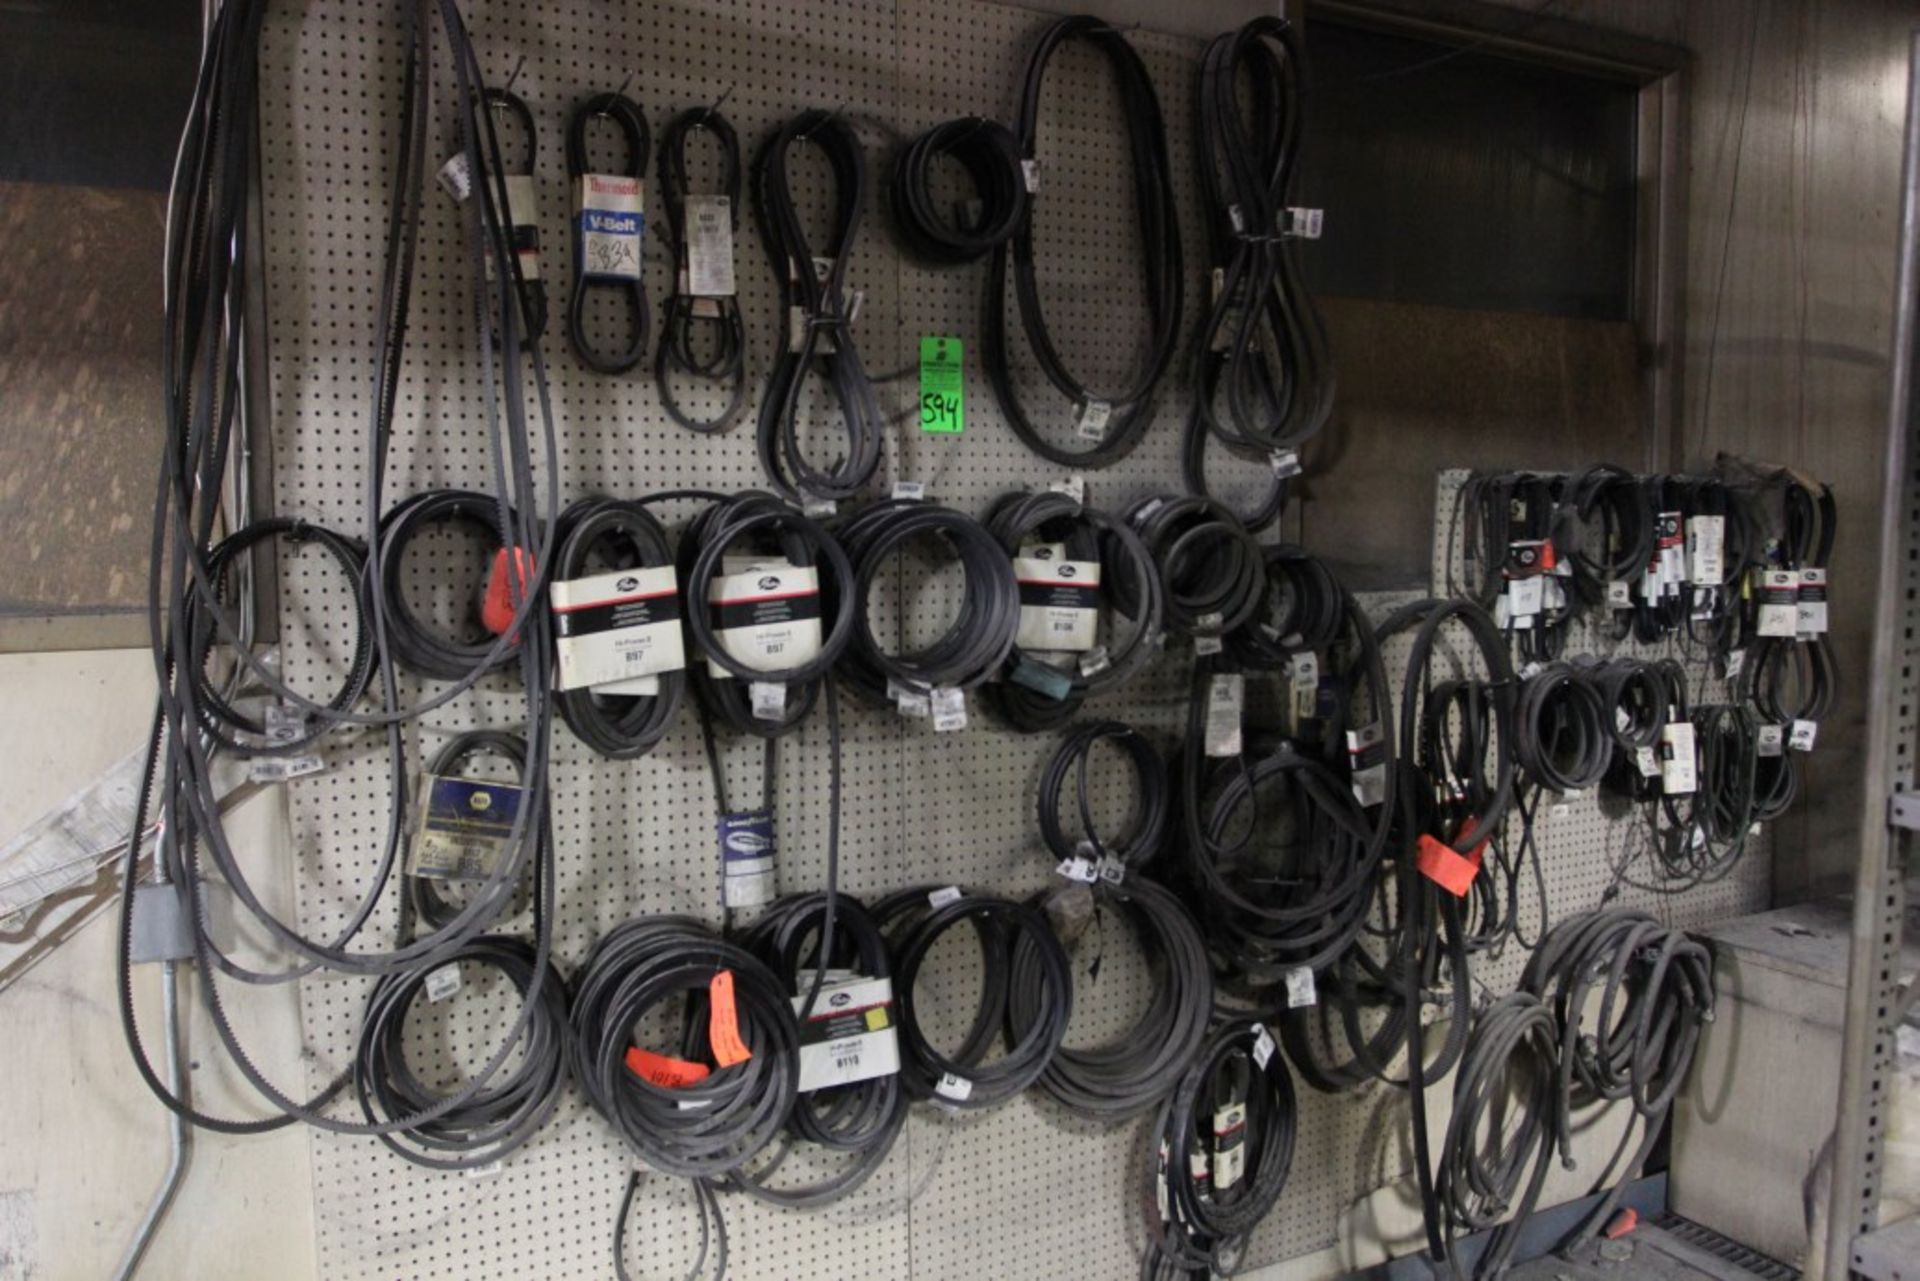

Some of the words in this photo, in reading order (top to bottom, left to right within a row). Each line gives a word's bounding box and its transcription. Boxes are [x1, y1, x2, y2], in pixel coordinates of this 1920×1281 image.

[589, 214, 636, 232] V-Belt
[922, 393, 959, 430] 594
[625, 650, 644, 662] B97
[766, 643, 785, 655] B97
